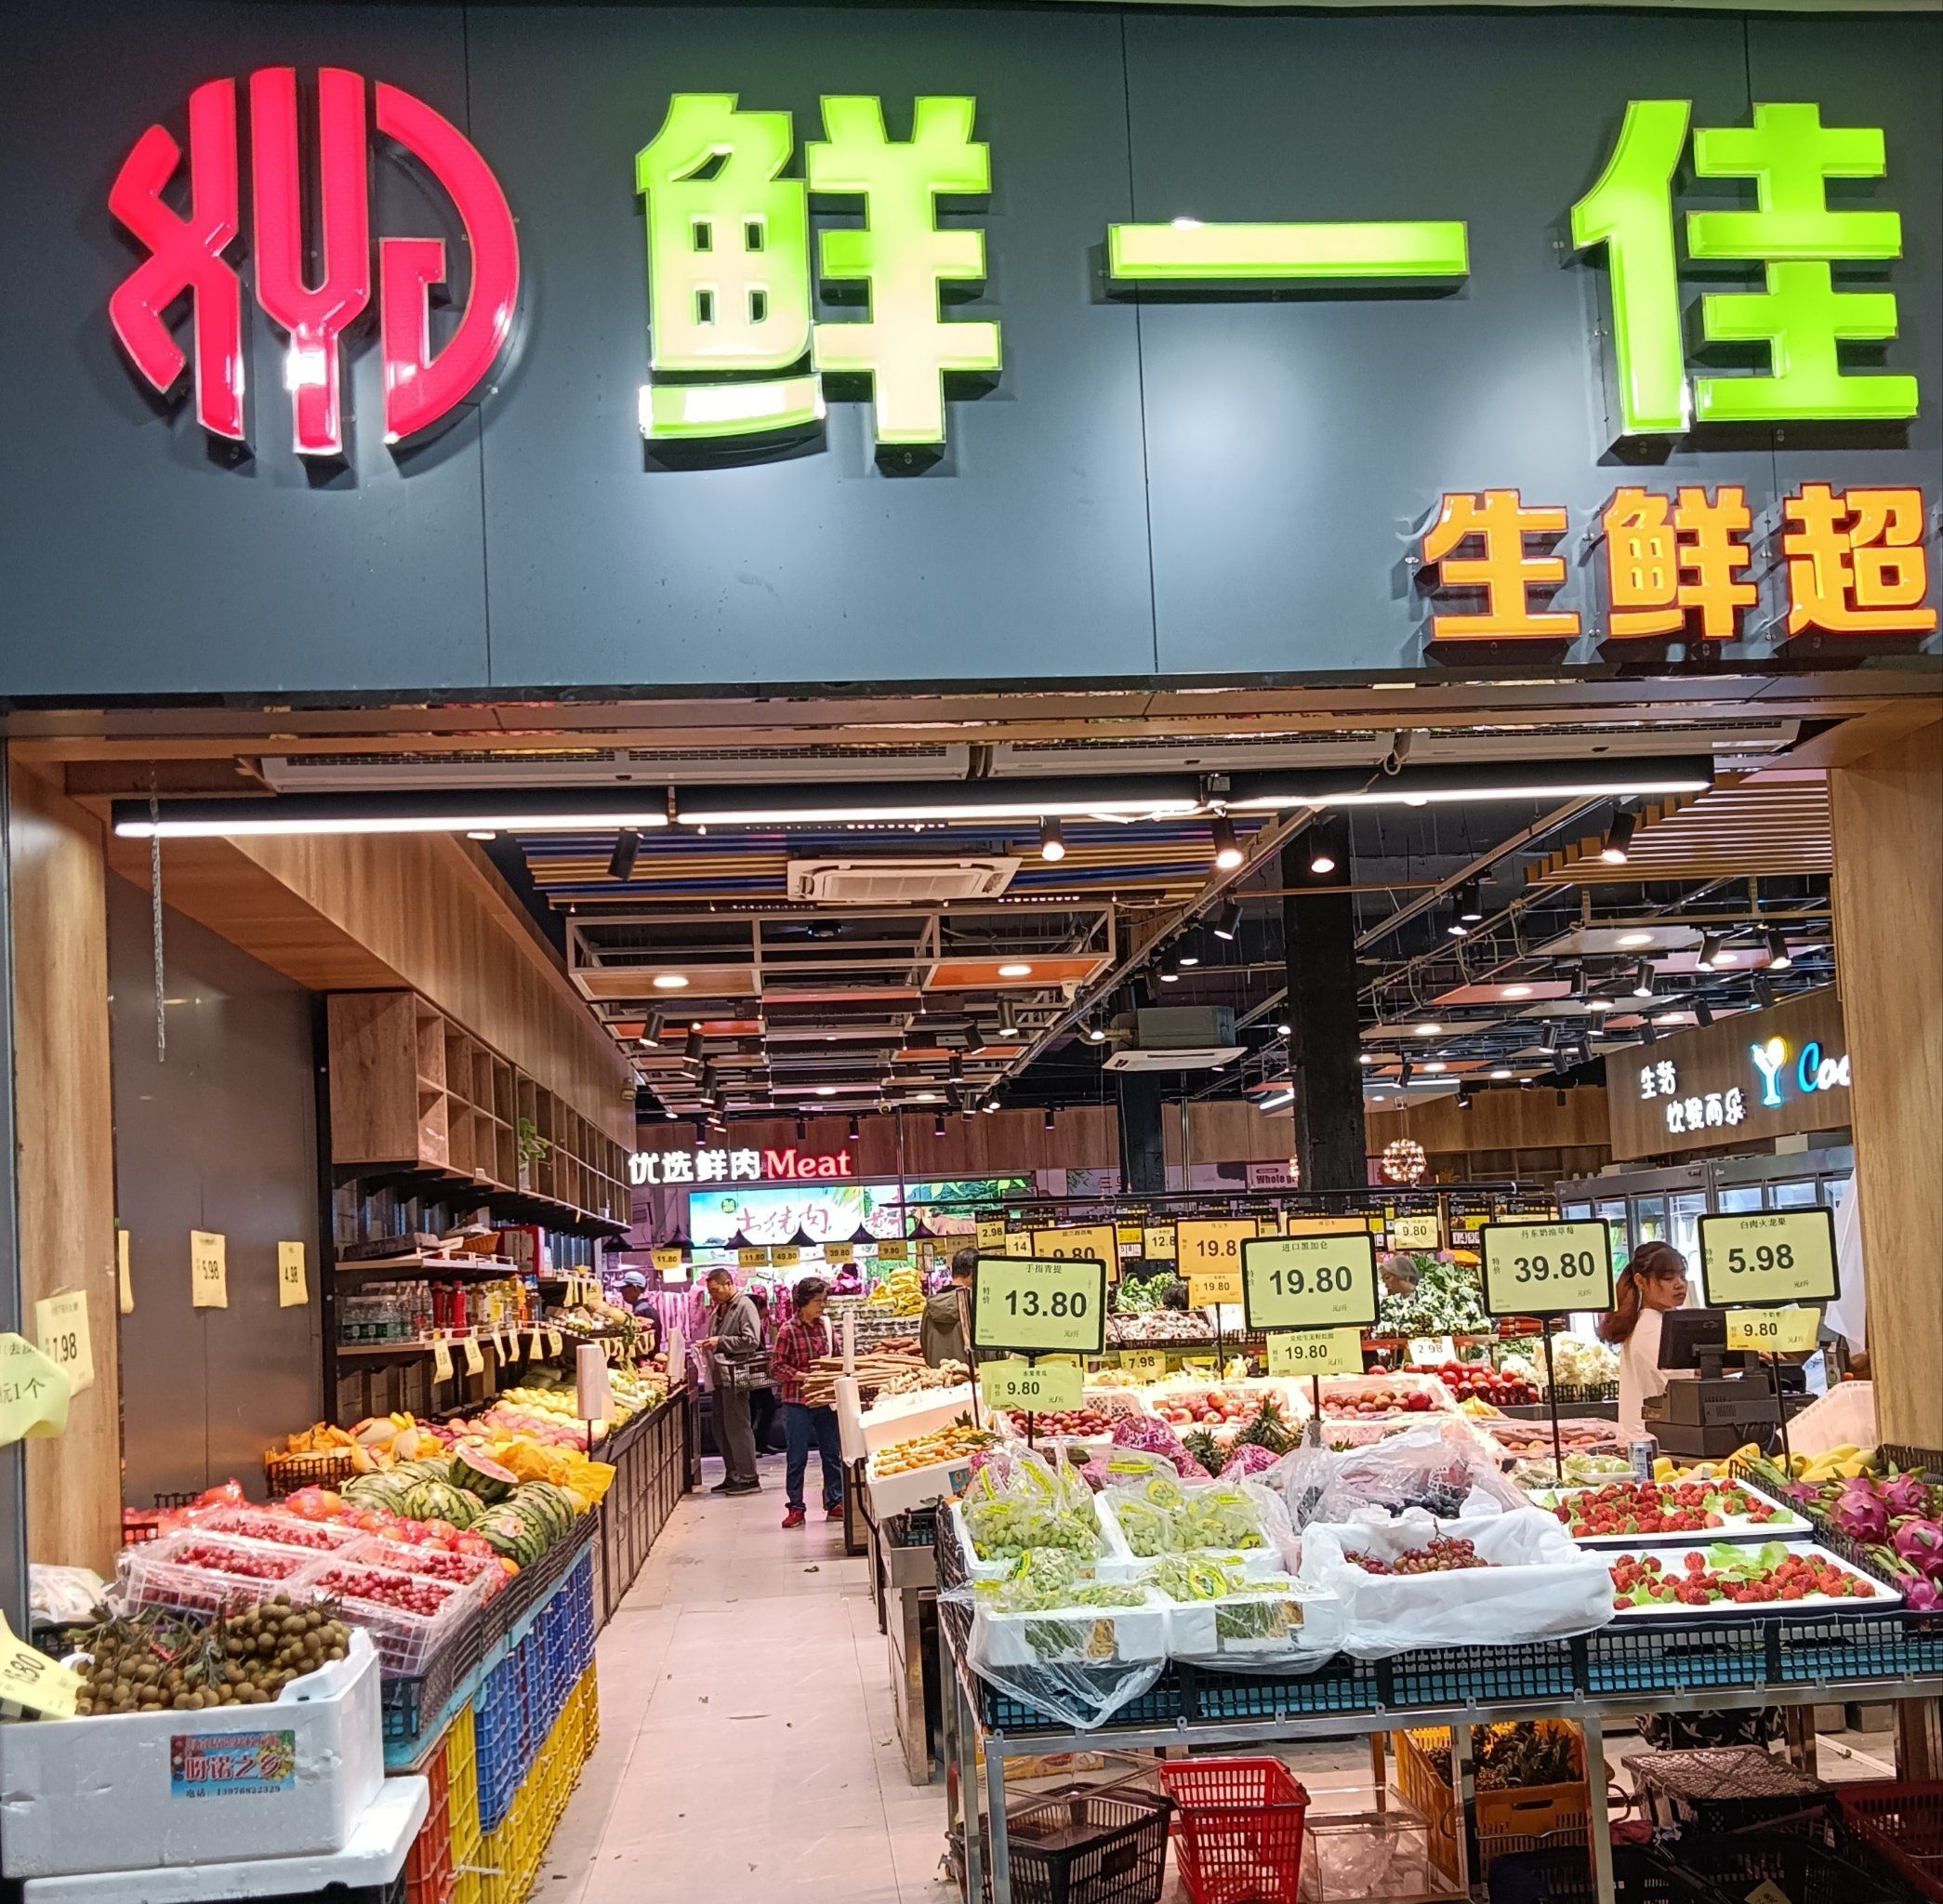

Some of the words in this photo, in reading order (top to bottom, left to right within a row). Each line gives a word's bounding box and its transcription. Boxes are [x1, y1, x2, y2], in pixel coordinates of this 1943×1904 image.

[635, 92, 1920, 447] 鲜一佳
[1422, 482, 1938, 640] 生鲜超
[628, 1148, 760, 1184] 优选鲜肉
[764, 1148, 852, 1179] Meat
[983, 1227, 1003, 1237] 2.98
[1402, 1225, 1427, 1236] 9.80
[1282, 1240, 1328, 1251] 进口黑加仑
[1728, 1244, 1794, 1273] 5.98
[1025, 1263, 1062, 1274] 手指青提
[1513, 1251, 1595, 1283] 39.80
[1269, 1265, 1353, 1295] 19.80
[1005, 1289, 1087, 1317] 13.80
[1743, 1322, 1778, 1336] 9.80
[1285, 1344, 1328, 1360] 19.80
[1129, 1356, 1156, 1368] 7.98
[1007, 1382, 1040, 1395] 9.80
